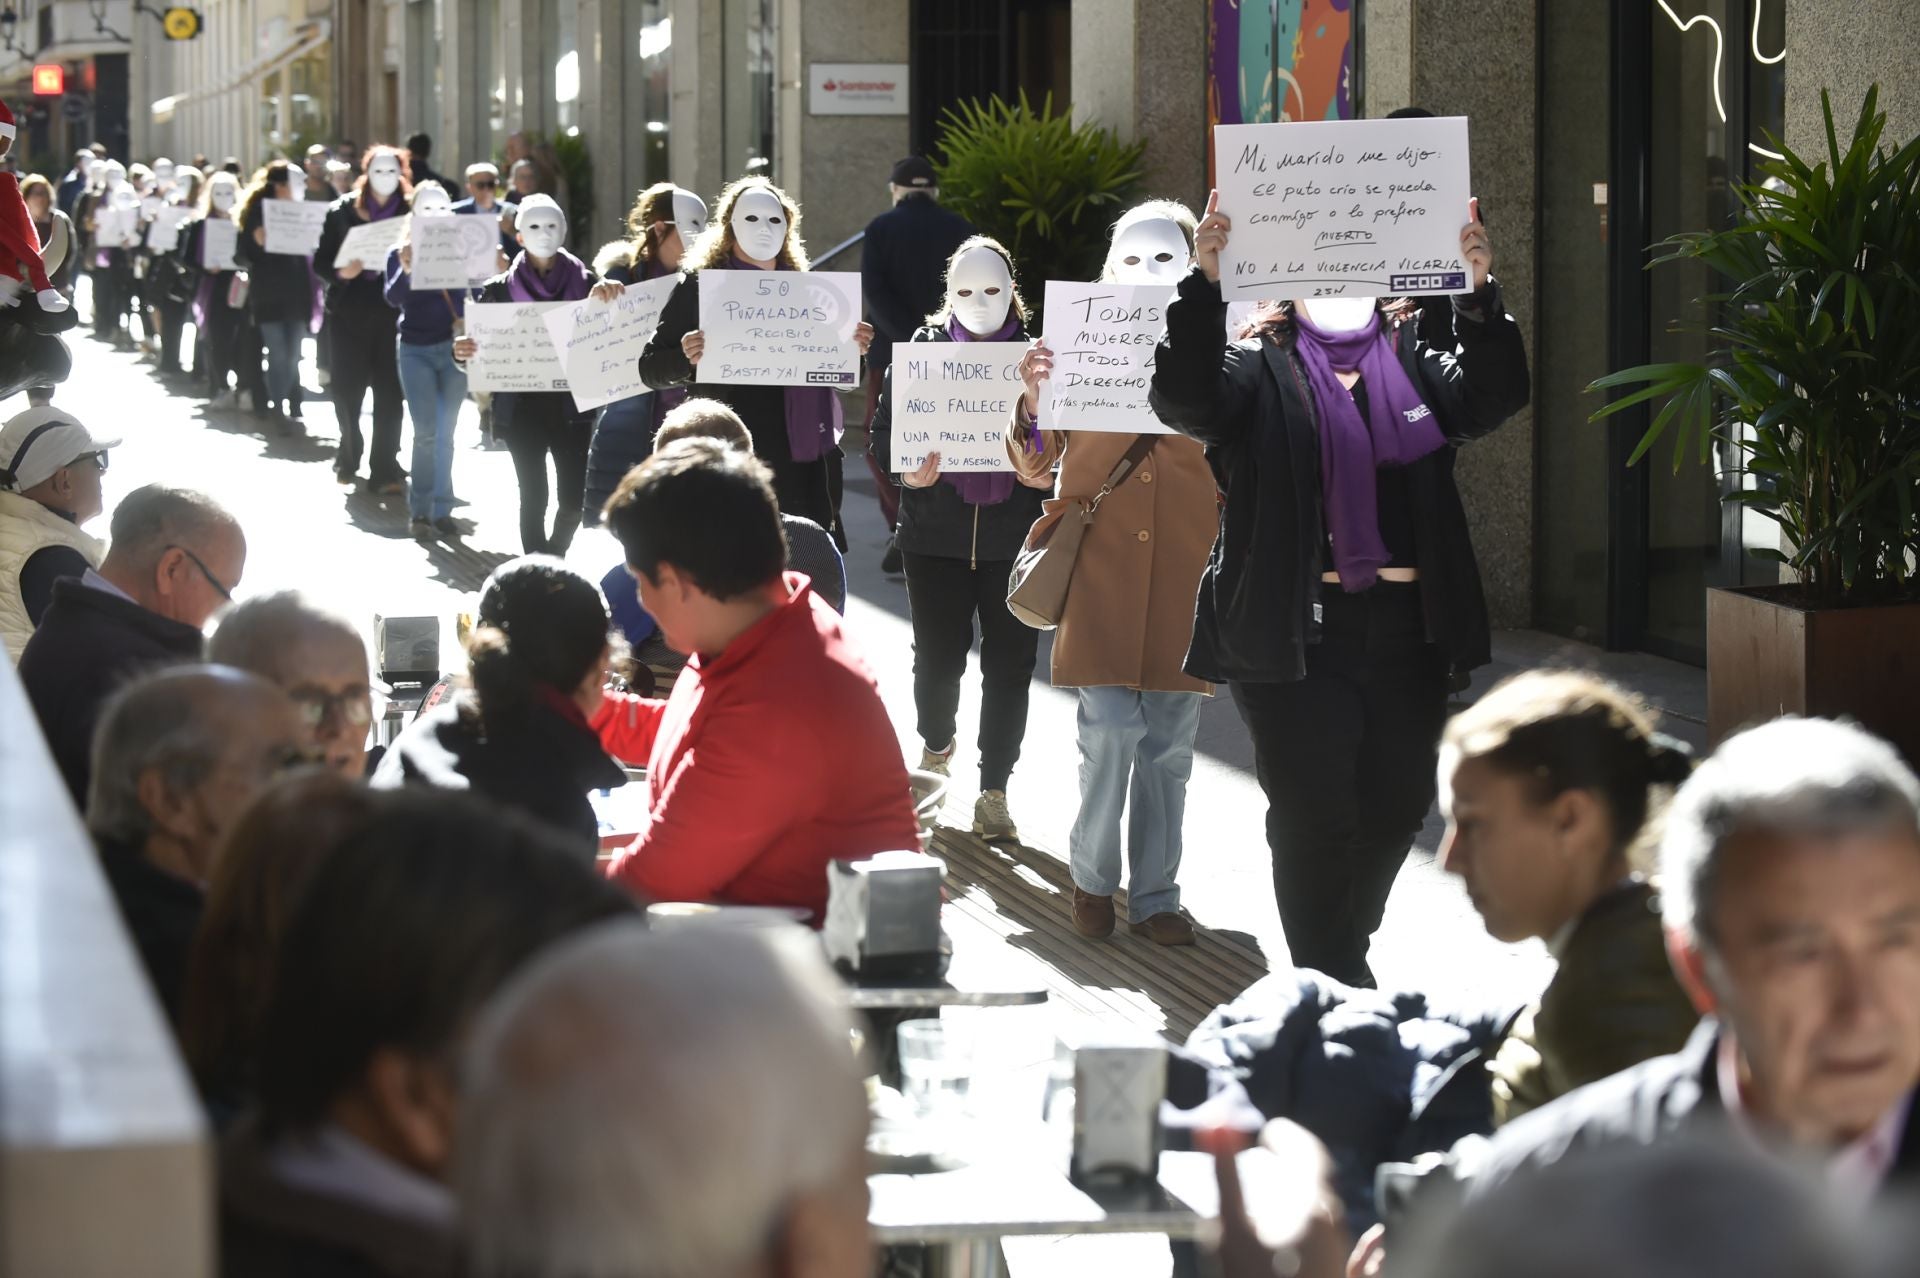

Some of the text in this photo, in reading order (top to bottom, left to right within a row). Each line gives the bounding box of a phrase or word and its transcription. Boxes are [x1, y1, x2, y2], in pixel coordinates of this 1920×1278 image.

[1235, 144, 1267, 173] Mi
[1357, 151, 1388, 164] me
[1253, 183, 1275, 197] El
[1282, 181, 1321, 202] puto
[1365, 183, 1383, 194] se
[1388, 180, 1438, 199] queda
[1250, 202, 1426, 229] conmigo o lo prefiero
[1236, 258, 1464, 276] NO A LA VIOLENCIA VICARIA
[756, 279, 790, 297] 50
[1313, 285, 1346, 297] 25N
[1393, 276, 1442, 290] CCOO
[722, 301, 827, 322] PUÑALADAS
[1071, 296, 1160, 324] TODAS
[1074, 331, 1155, 346] MUJERES
[722, 343, 839, 354] POR SU PAREJA
[817, 360, 848, 370] 25N
[1062, 351, 1129, 366] TODOS
[720, 363, 771, 379] BASTA
[908, 361, 1022, 381] MI MADRE CO
[906, 398, 1007, 414] AÑOS FALLECE
[903, 431, 1001, 443] UNA PALIZA EN
[901, 456, 912, 466] MI
[948, 457, 959, 466] SU
[963, 457, 1001, 467] ASESINO
